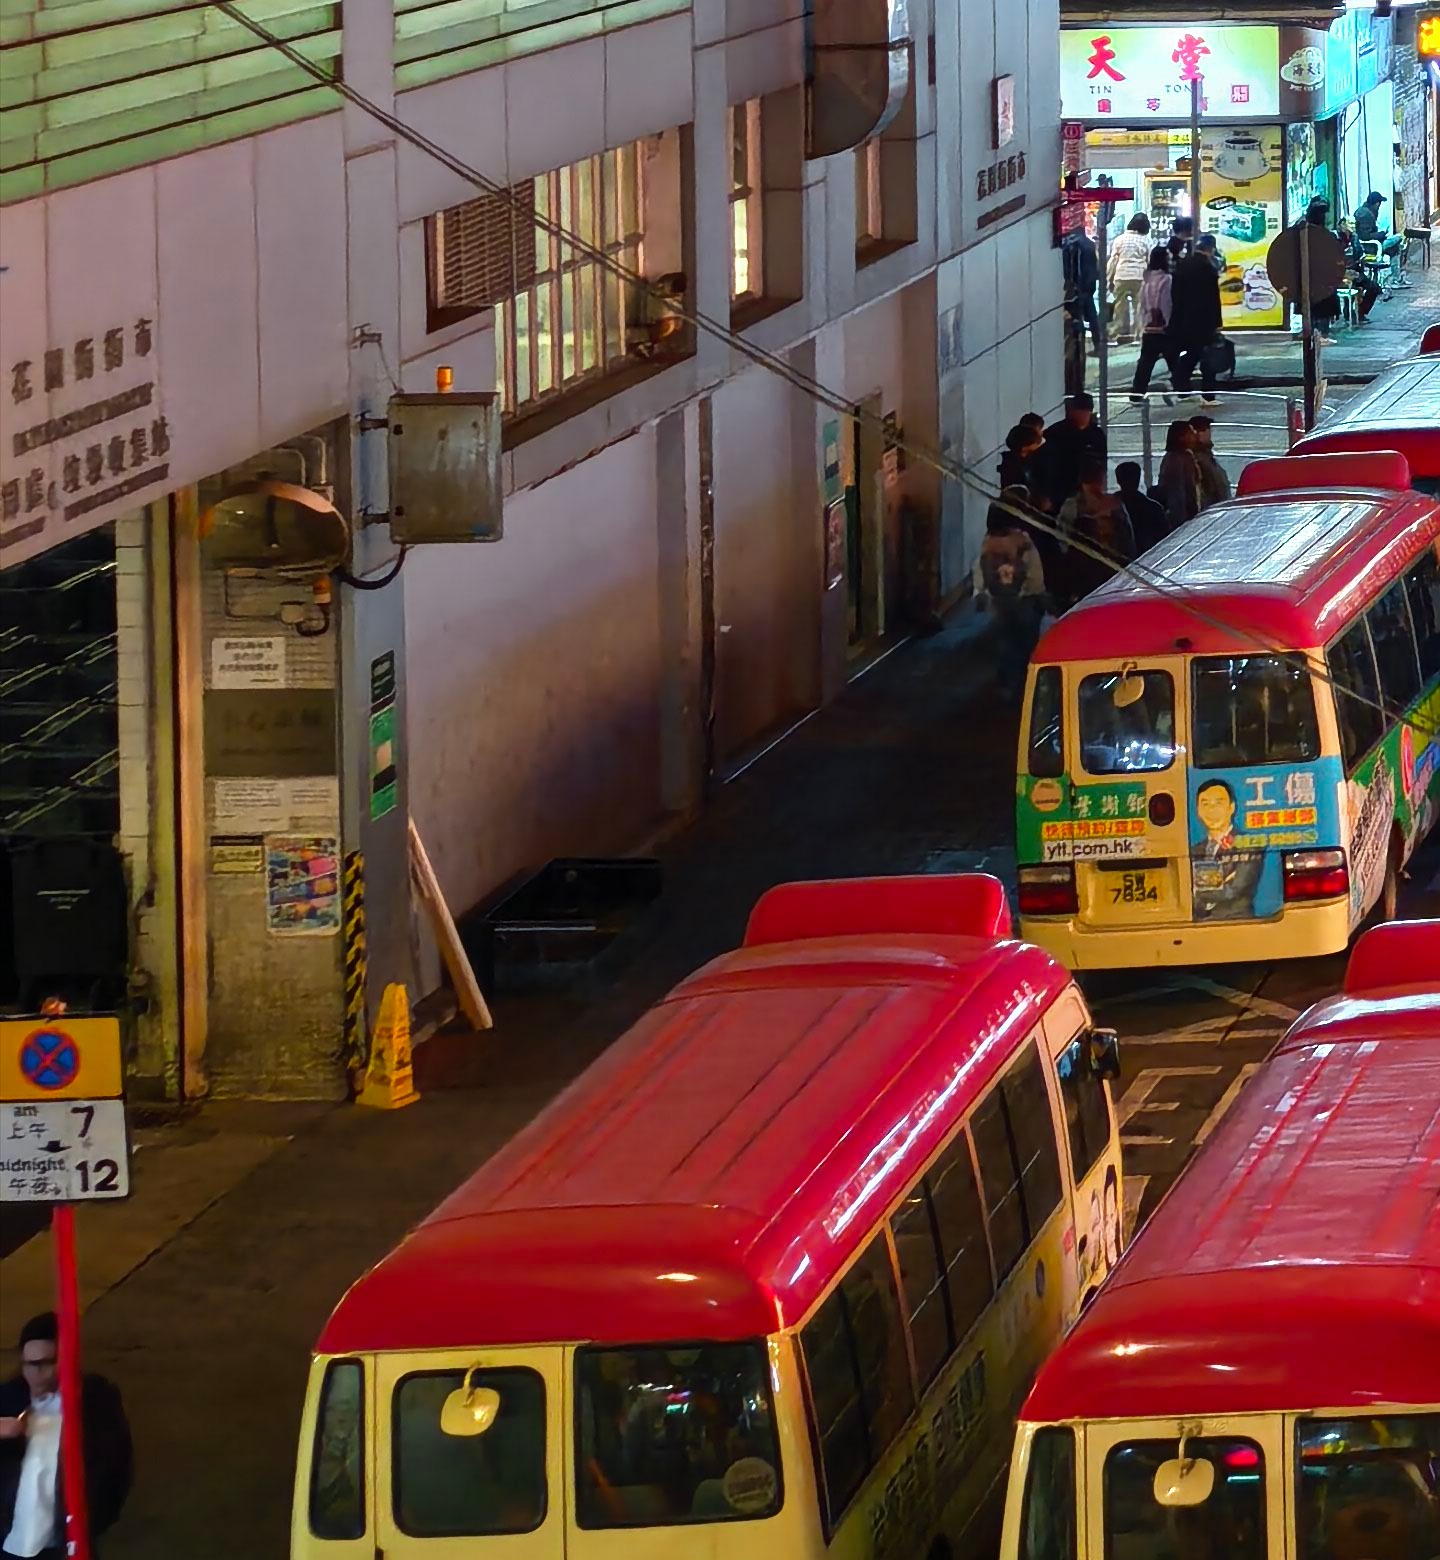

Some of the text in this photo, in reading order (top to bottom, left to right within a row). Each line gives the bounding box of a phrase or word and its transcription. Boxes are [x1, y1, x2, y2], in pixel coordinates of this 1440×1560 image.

[1089, 85, 1112, 94] TIN
[1245, 773, 1317, 806] 工傷
[7, 1122, 49, 1140] 上午
[70, 1105, 95, 1138] 7
[75, 1159, 118, 1192] 12
